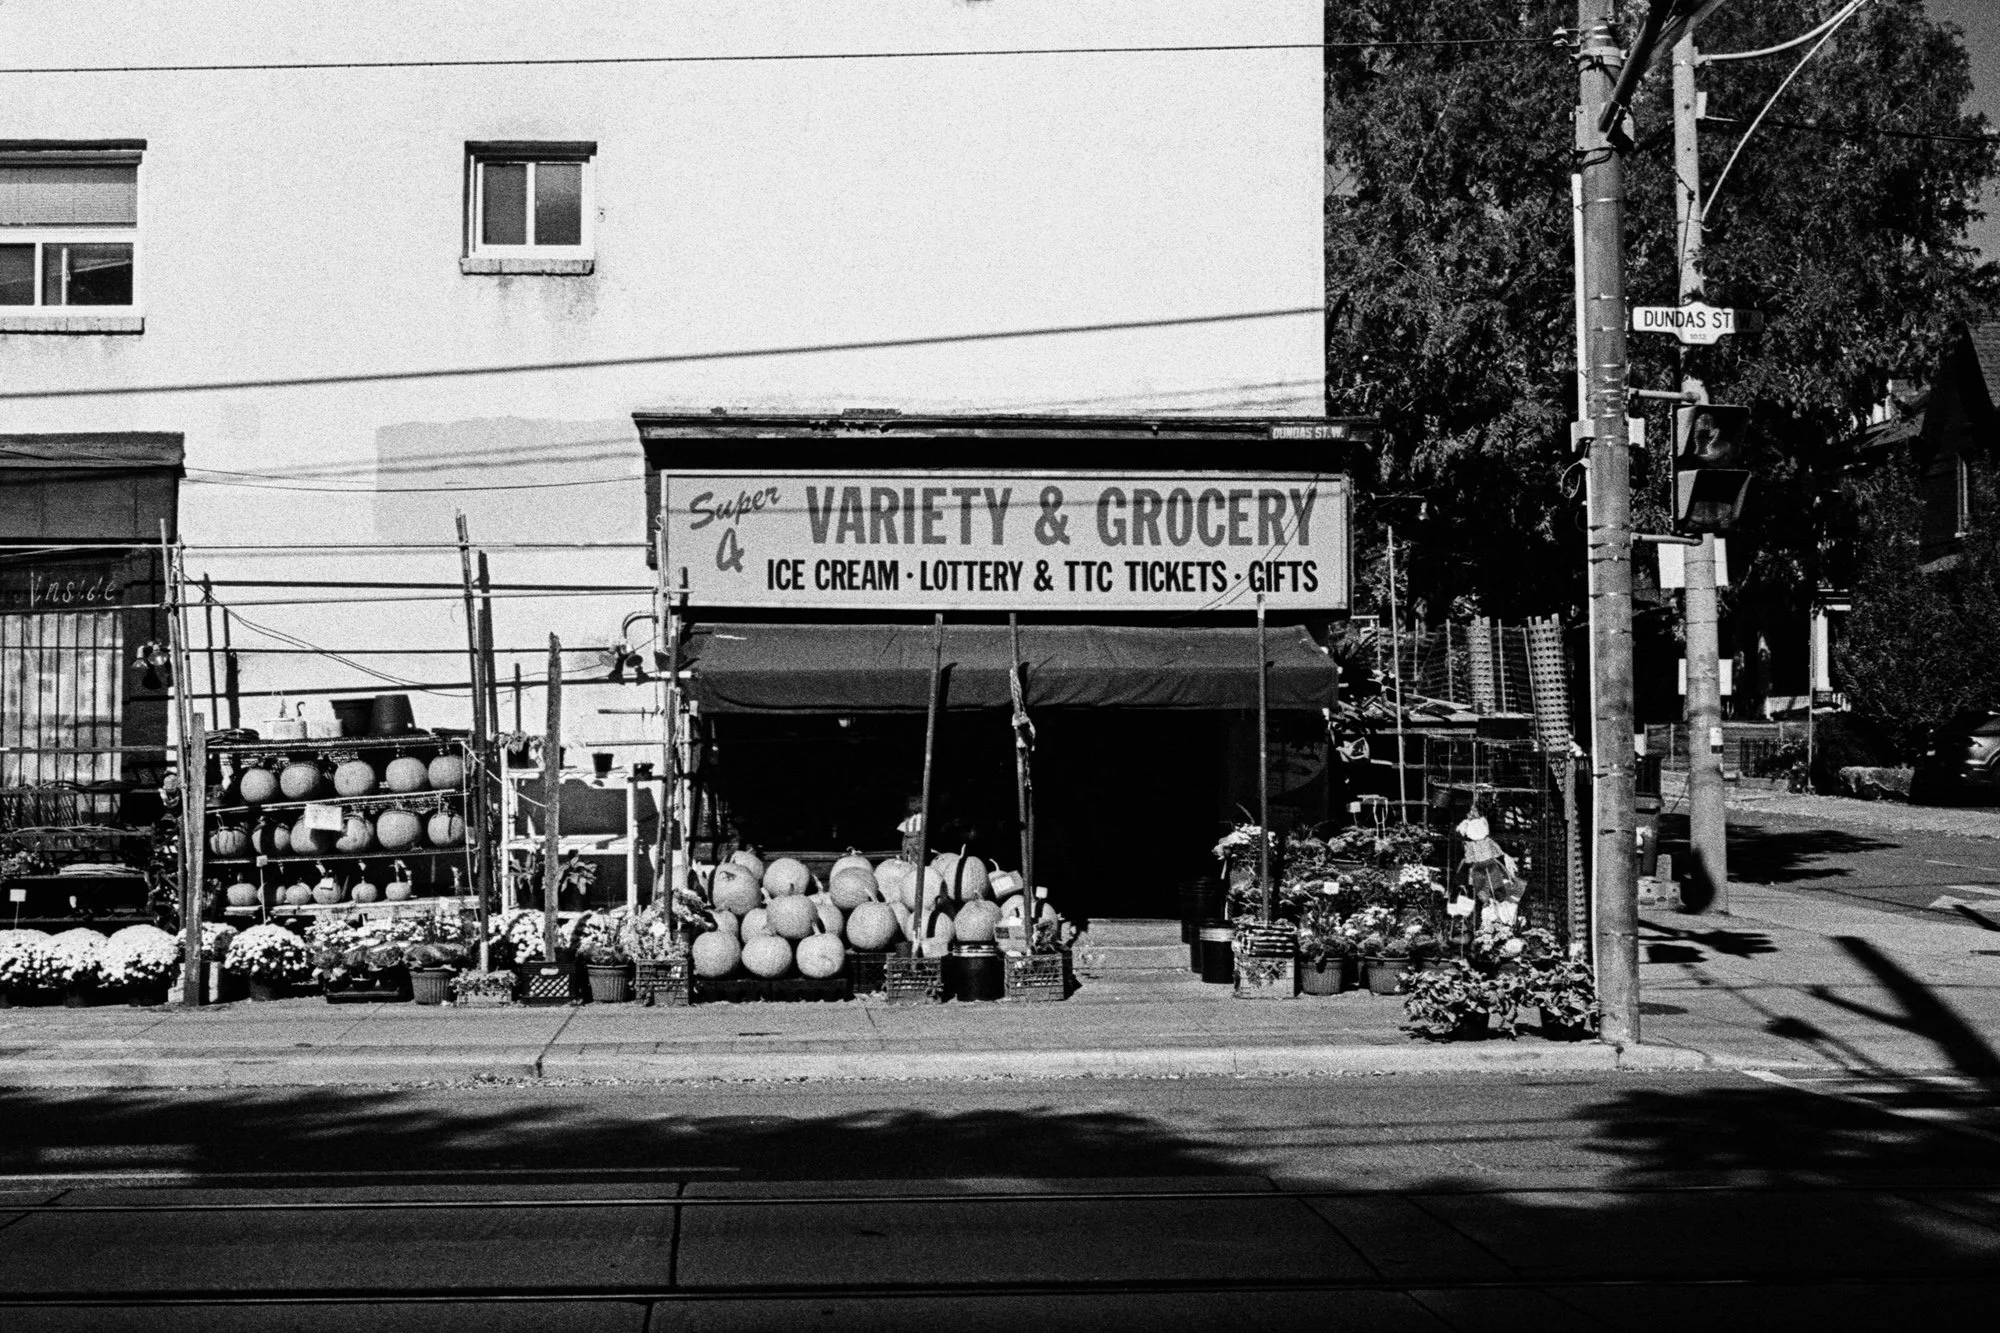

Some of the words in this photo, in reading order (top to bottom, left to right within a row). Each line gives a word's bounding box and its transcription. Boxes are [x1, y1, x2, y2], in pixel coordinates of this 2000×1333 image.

[1644, 310, 1706, 328] DUNDAS
[1272, 426, 1312, 439] DUNDAS
[689, 487, 781, 530] Super
[806, 485, 1013, 545] VARIETY
[1035, 485, 1070, 547] &
[1097, 486, 1317, 547] GROCERY
[769, 560, 804, 590] ICE
[815, 560, 899, 591] CREAM
[921, 560, 1022, 591] LOTTERY
[1035, 560, 1053, 591] &
[1065, 561, 1112, 592] TTC
[1125, 560, 1227, 592] TICKETS
[1249, 560, 1318, 592] GIFTS
